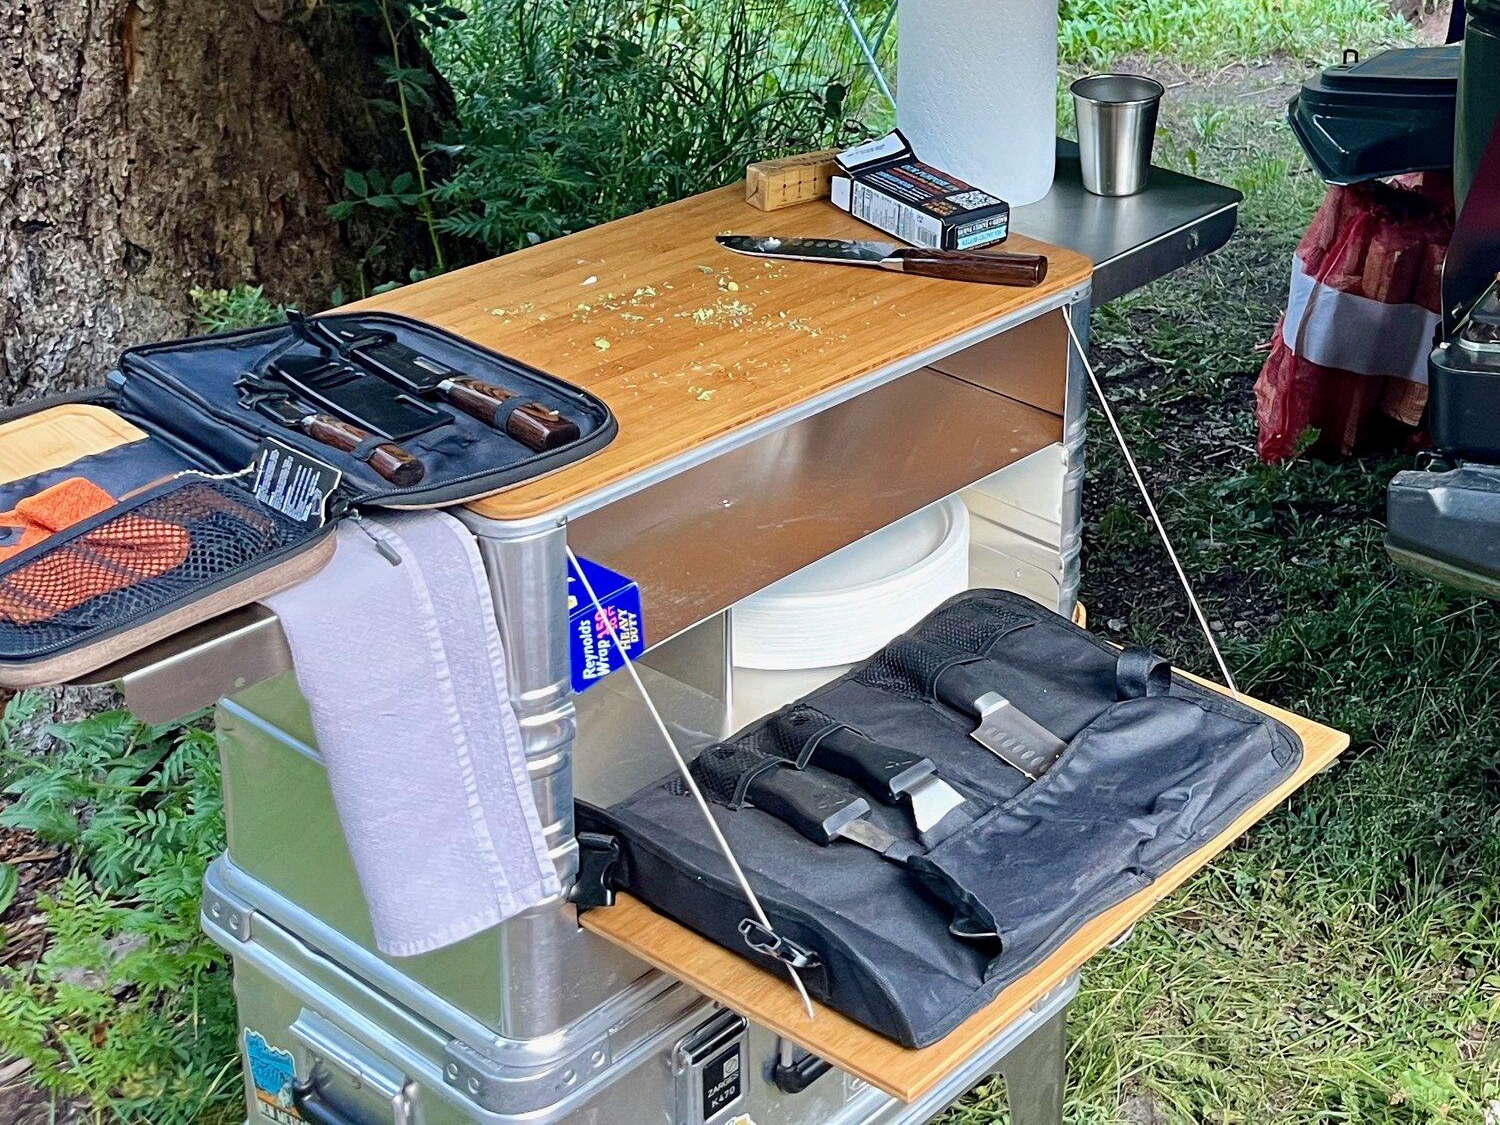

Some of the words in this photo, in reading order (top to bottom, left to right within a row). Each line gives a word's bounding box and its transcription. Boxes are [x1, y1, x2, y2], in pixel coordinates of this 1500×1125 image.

[617, 608, 632, 650] HEAVY
[628, 612, 639, 643] DUTY
[578, 619, 598, 679] Reynolds
[596, 639, 611, 676] Wrap
[708, 1071, 739, 1098] ZARGES
[711, 1086, 735, 1108] K470
